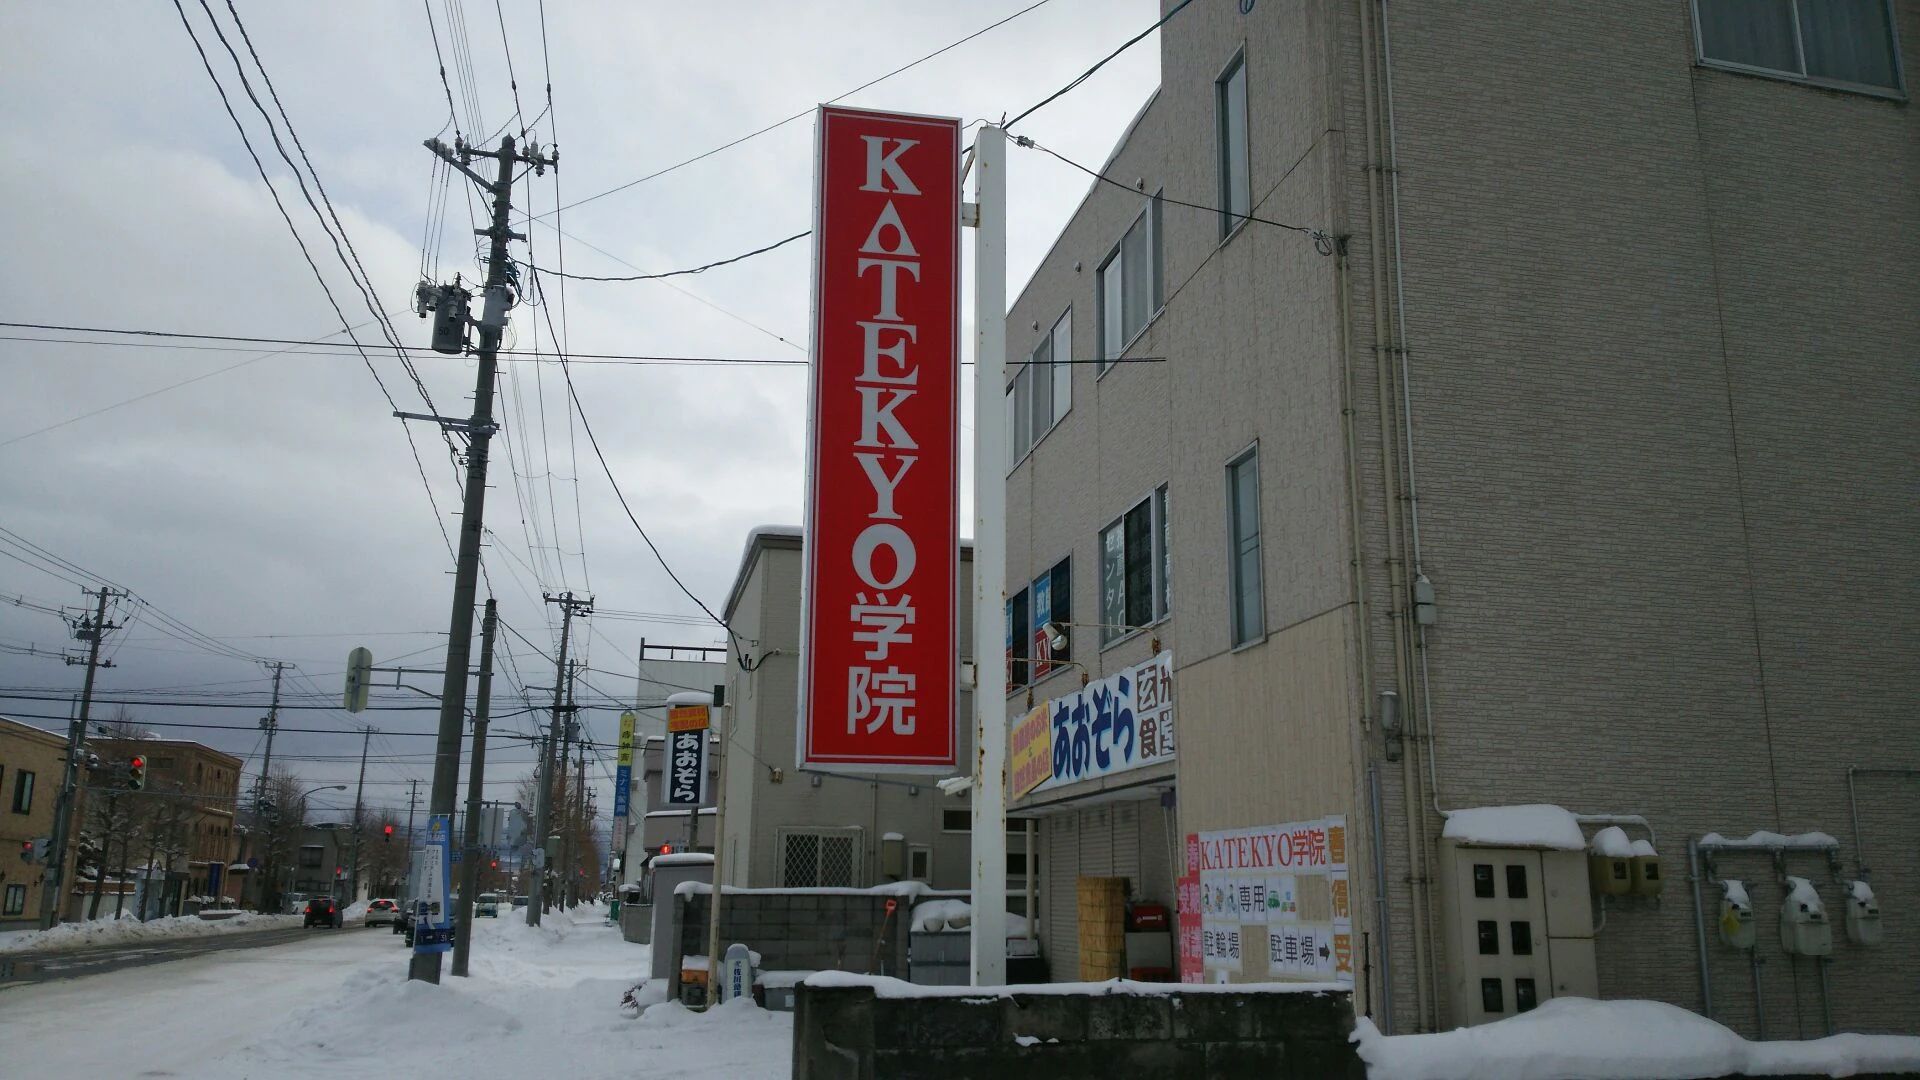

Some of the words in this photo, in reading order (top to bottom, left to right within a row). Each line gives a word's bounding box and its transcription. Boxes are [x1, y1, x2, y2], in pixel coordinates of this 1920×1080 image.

[847, 134, 922, 735] KATEKYO学院
[1053, 675, 1135, 780] あおぞら
[674, 732, 699, 802] あおぞら
[1200, 828, 1326, 870] KATEKYO学院
[1239, 885, 1265, 913] 専用
[1204, 930, 1240, 960] 駐輪場
[1270, 934, 1315, 966] 駐車場
